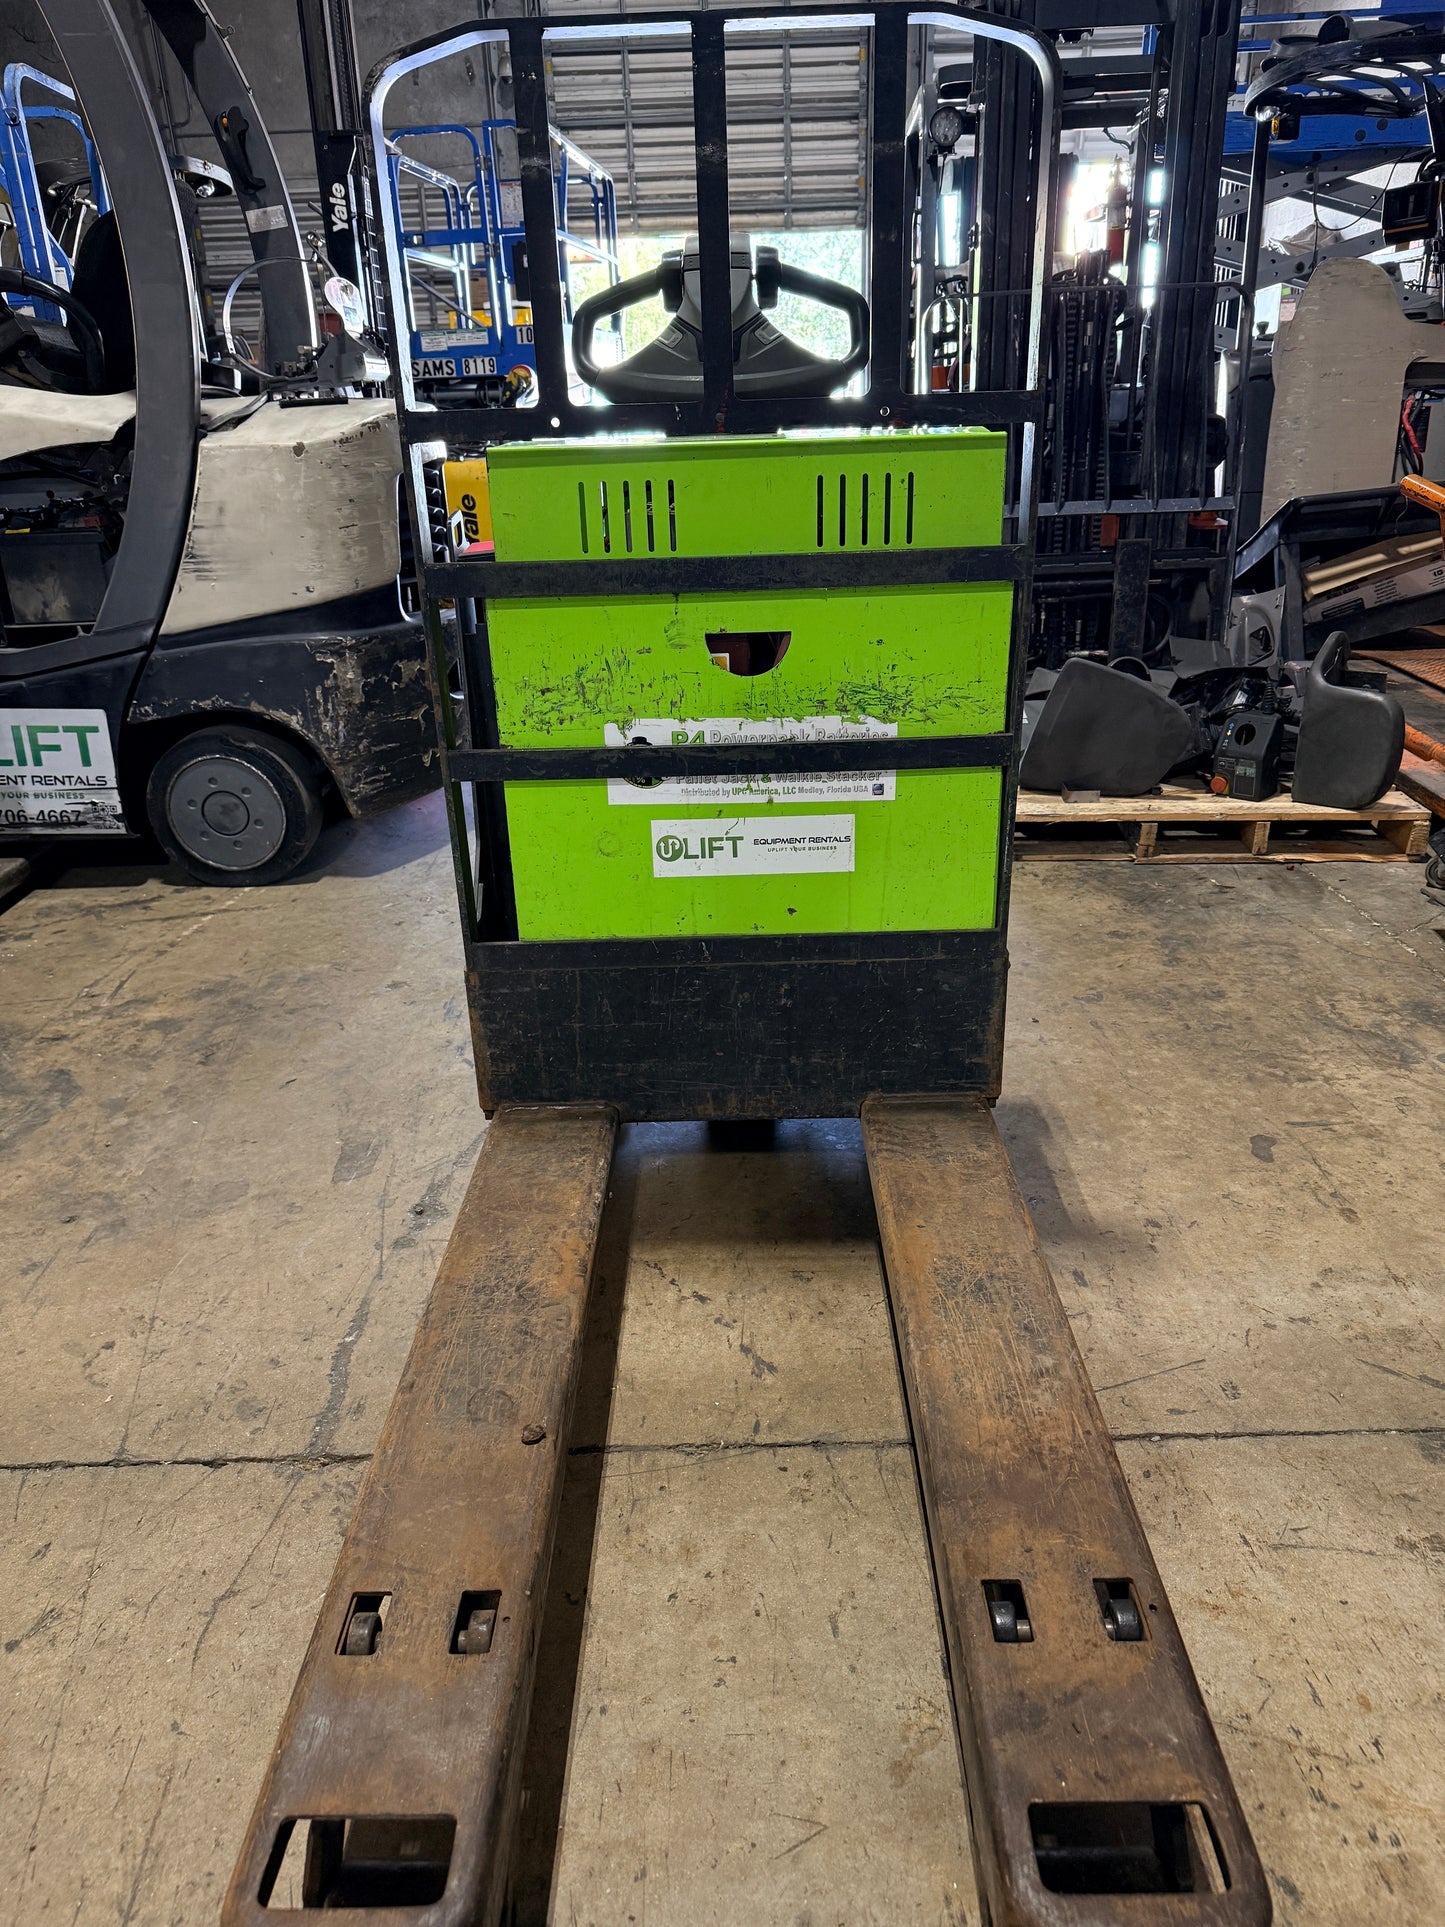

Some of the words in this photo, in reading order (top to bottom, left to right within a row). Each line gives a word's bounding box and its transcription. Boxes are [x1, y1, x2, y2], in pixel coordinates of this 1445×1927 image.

[329, 182, 349, 232] Yale
[412, 360, 455, 378] SAMS
[464, 357, 496, 375] 8119
[31, 775, 108, 786] RENTALS
[1, 791, 30, 799] YOUR
[33, 791, 86, 800] BUSINESS
[722, 787, 731, 798] by
[782, 785, 797, 795] LLC
[853, 783, 869, 793] USA
[0, 808, 82, 824] 06-4667
[753, 837, 807, 846] EQUIPMENT
[808, 835, 851, 844] RENTALS
